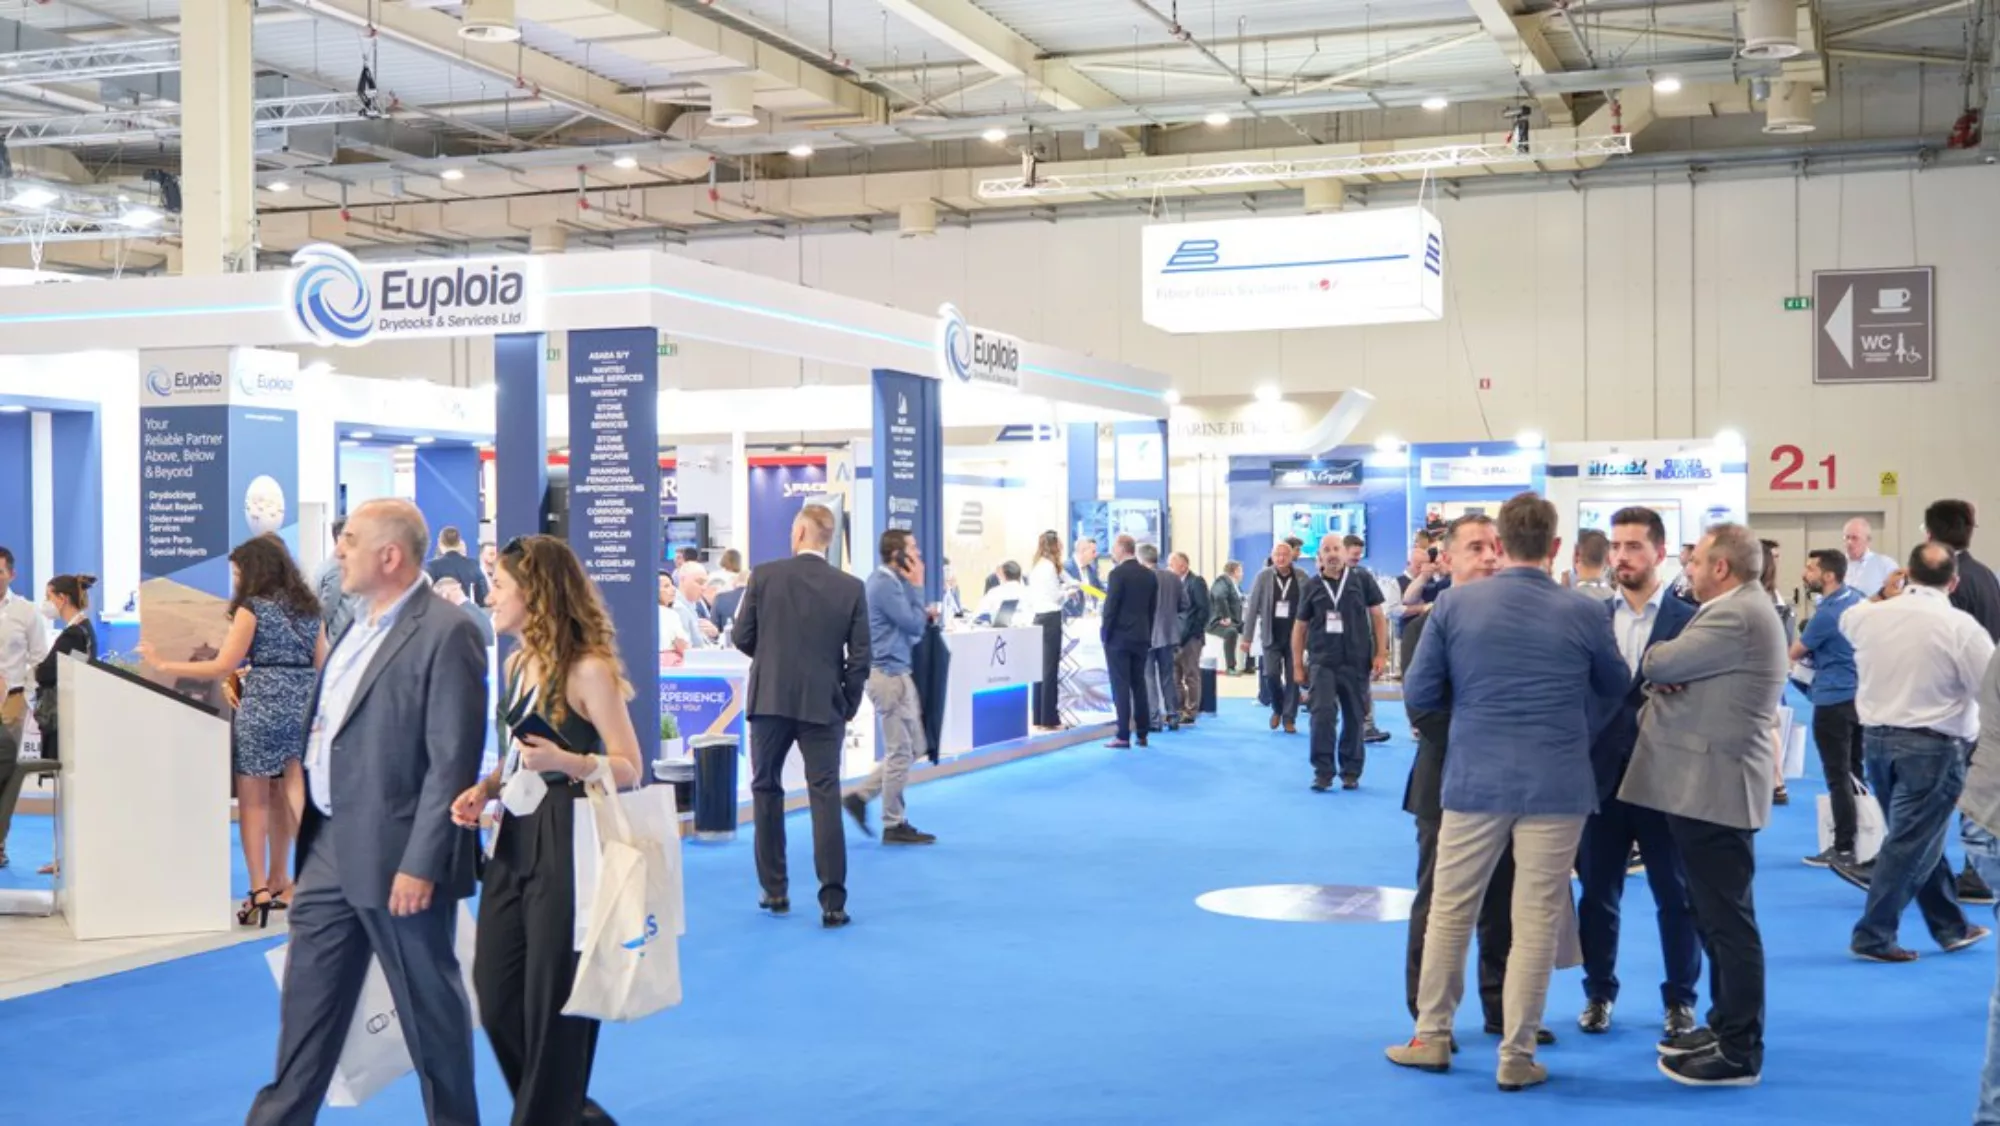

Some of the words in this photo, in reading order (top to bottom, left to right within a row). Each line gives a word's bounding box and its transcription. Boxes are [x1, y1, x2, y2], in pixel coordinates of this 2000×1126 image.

[381, 265, 523, 316] Euploia
[1157, 286, 1191, 300] Fiber
[379, 315, 433, 331] Drydocks
[437, 316, 445, 327] &
[447, 313, 498, 327] Services
[501, 312, 521, 325] Ltd
[1860, 334, 1892, 351] WC
[974, 333, 1019, 373] Euploia
[174, 371, 222, 390] Euploia
[575, 375, 605, 383] MARINE
[606, 374, 644, 382] SERVICES
[594, 412, 624, 420] MARINE
[145, 418, 169, 430] Your
[590, 421, 628, 429] SERVICES
[145, 434, 184, 446] Reliable
[186, 433, 223, 445] Partner
[596, 435, 622, 443] STONE
[145, 450, 180, 462] Above,
[183, 449, 215, 461] Below
[155, 465, 192, 480] Beyond
[1769, 444, 1836, 490] 2.1
[149, 490, 196, 501] Drydockings
[174, 503, 203, 512] Repairs
[149, 515, 196, 523] Underwater
[149, 524, 181, 532] Services
[149, 536, 171, 545] Spare
[149, 548, 176, 557] Special
[178, 547, 207, 557] Projects
[660, 691, 725, 702] XPERIENCE
